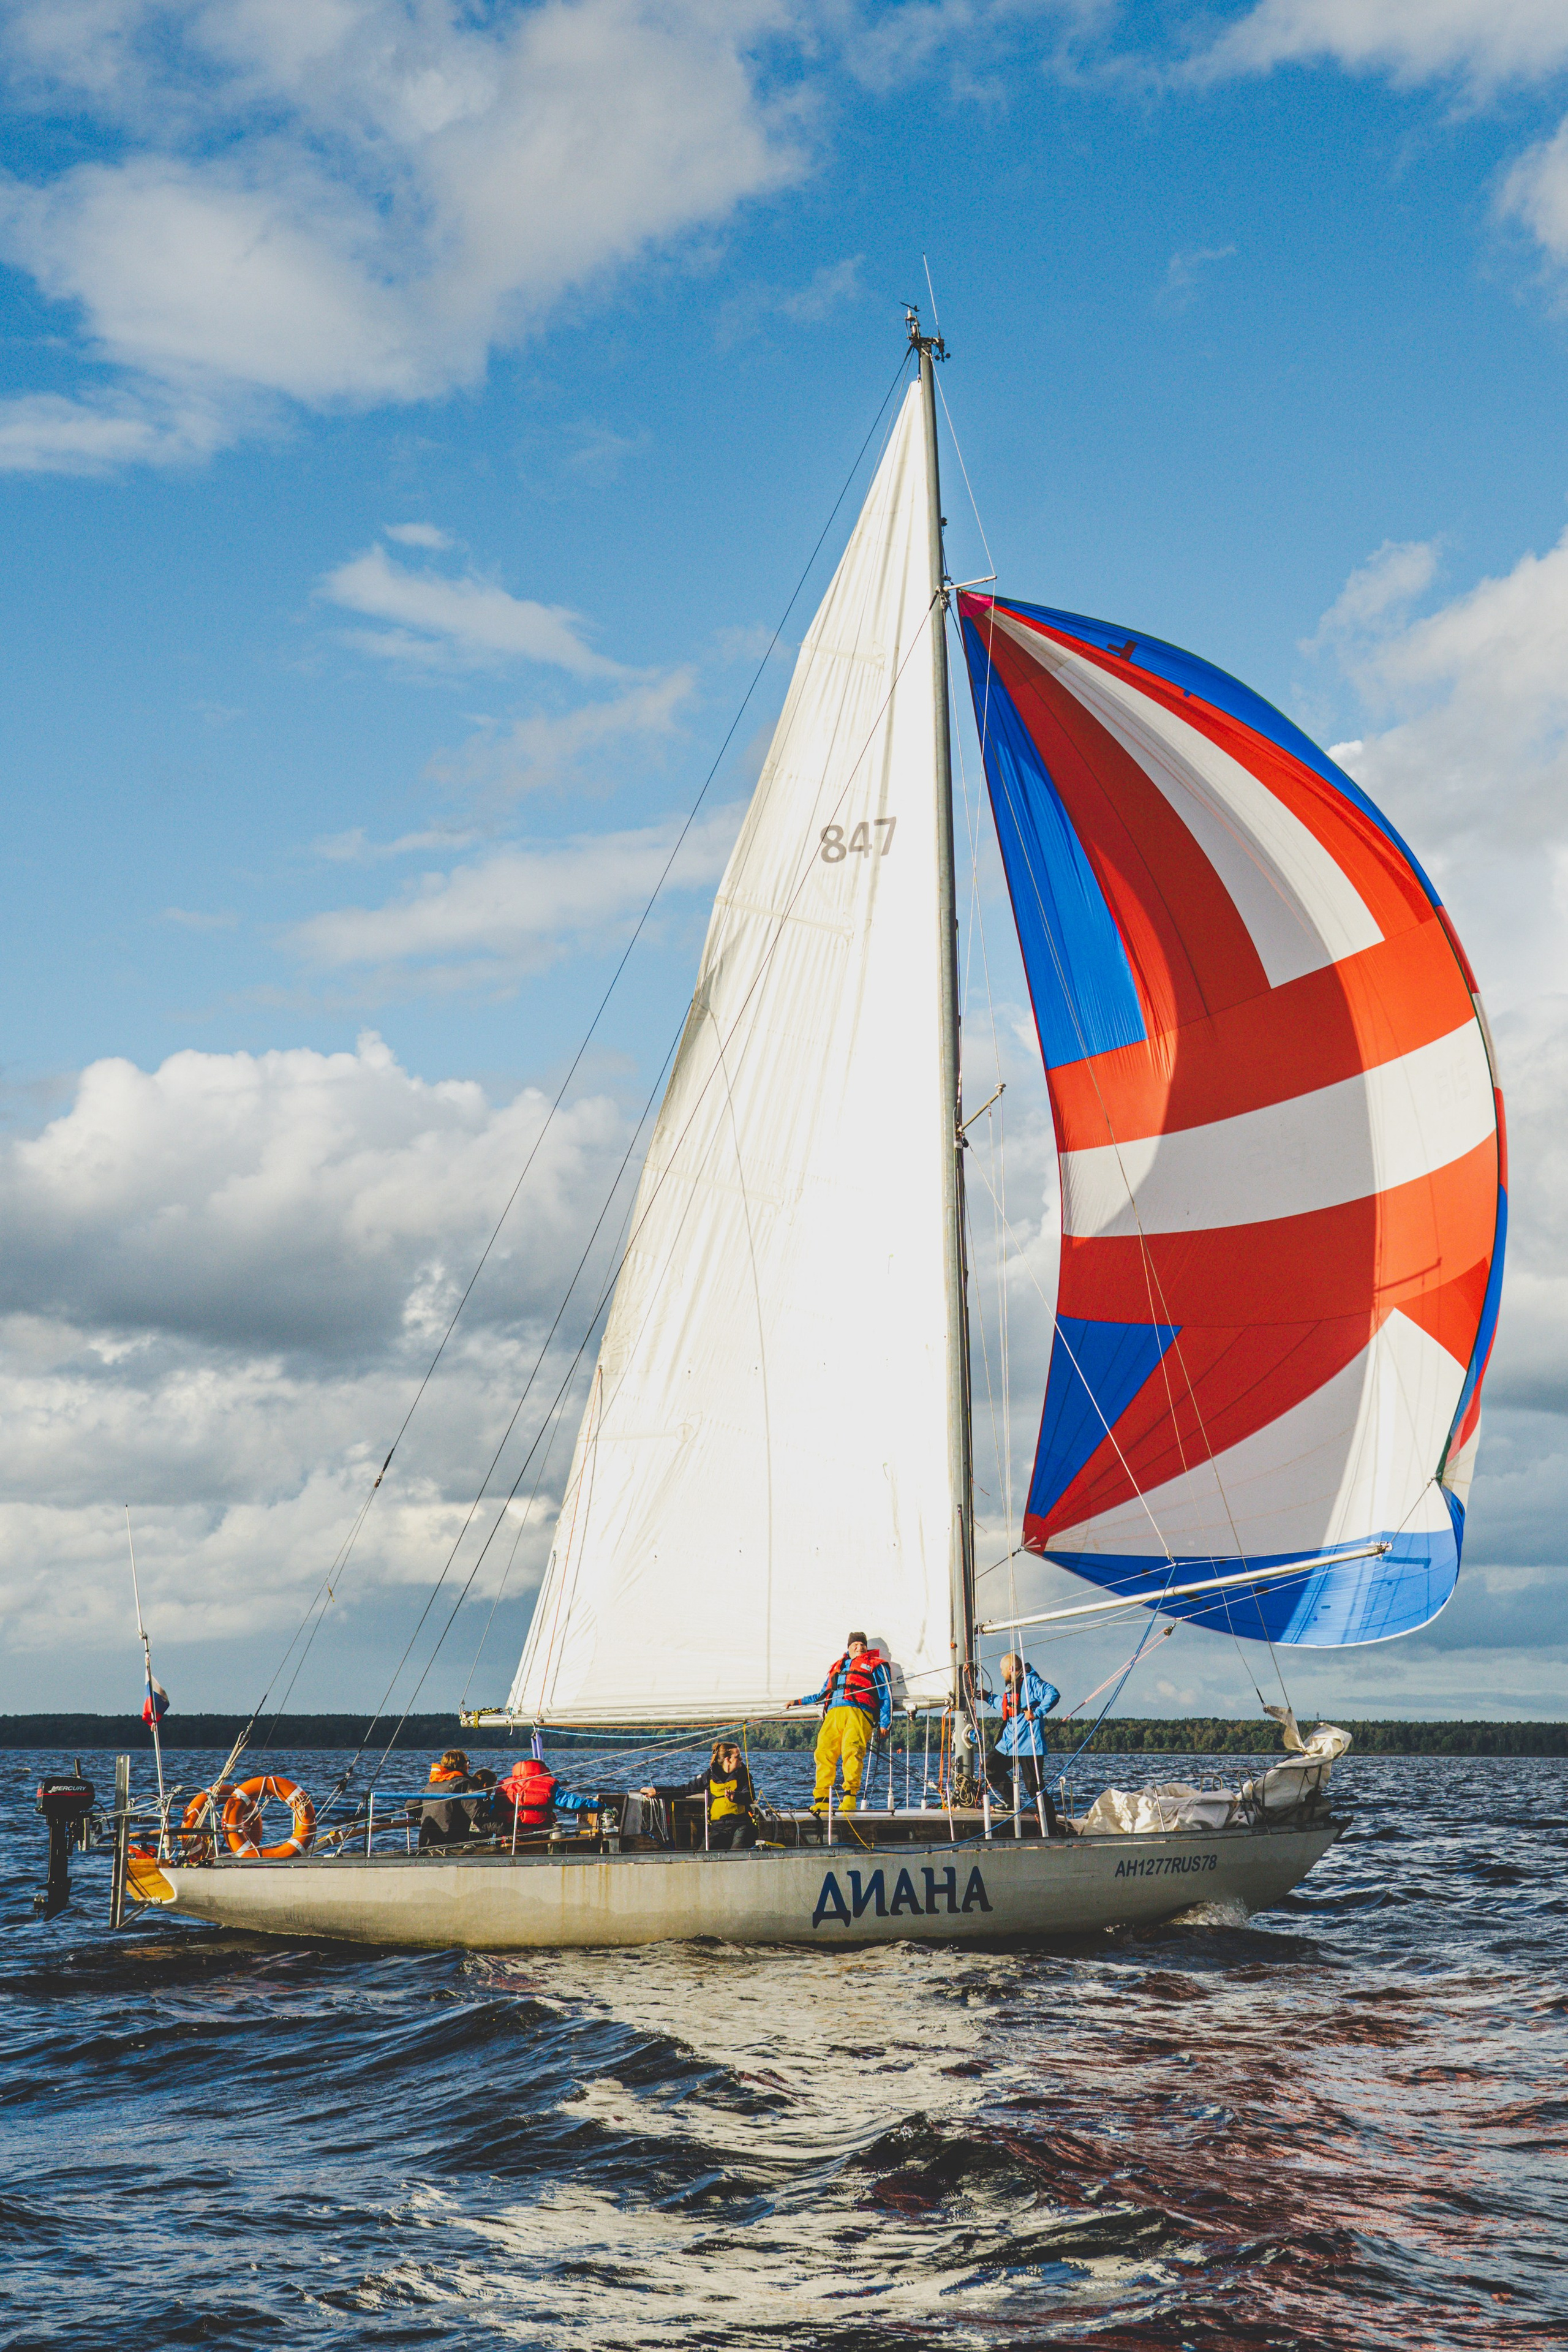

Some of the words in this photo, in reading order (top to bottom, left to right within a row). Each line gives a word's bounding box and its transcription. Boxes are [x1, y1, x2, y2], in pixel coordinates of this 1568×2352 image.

[820, 816, 897, 864] 847
[1115, 1854, 1218, 1878] AH1277RUS78
[812, 1866, 993, 1929] ДИАНА
